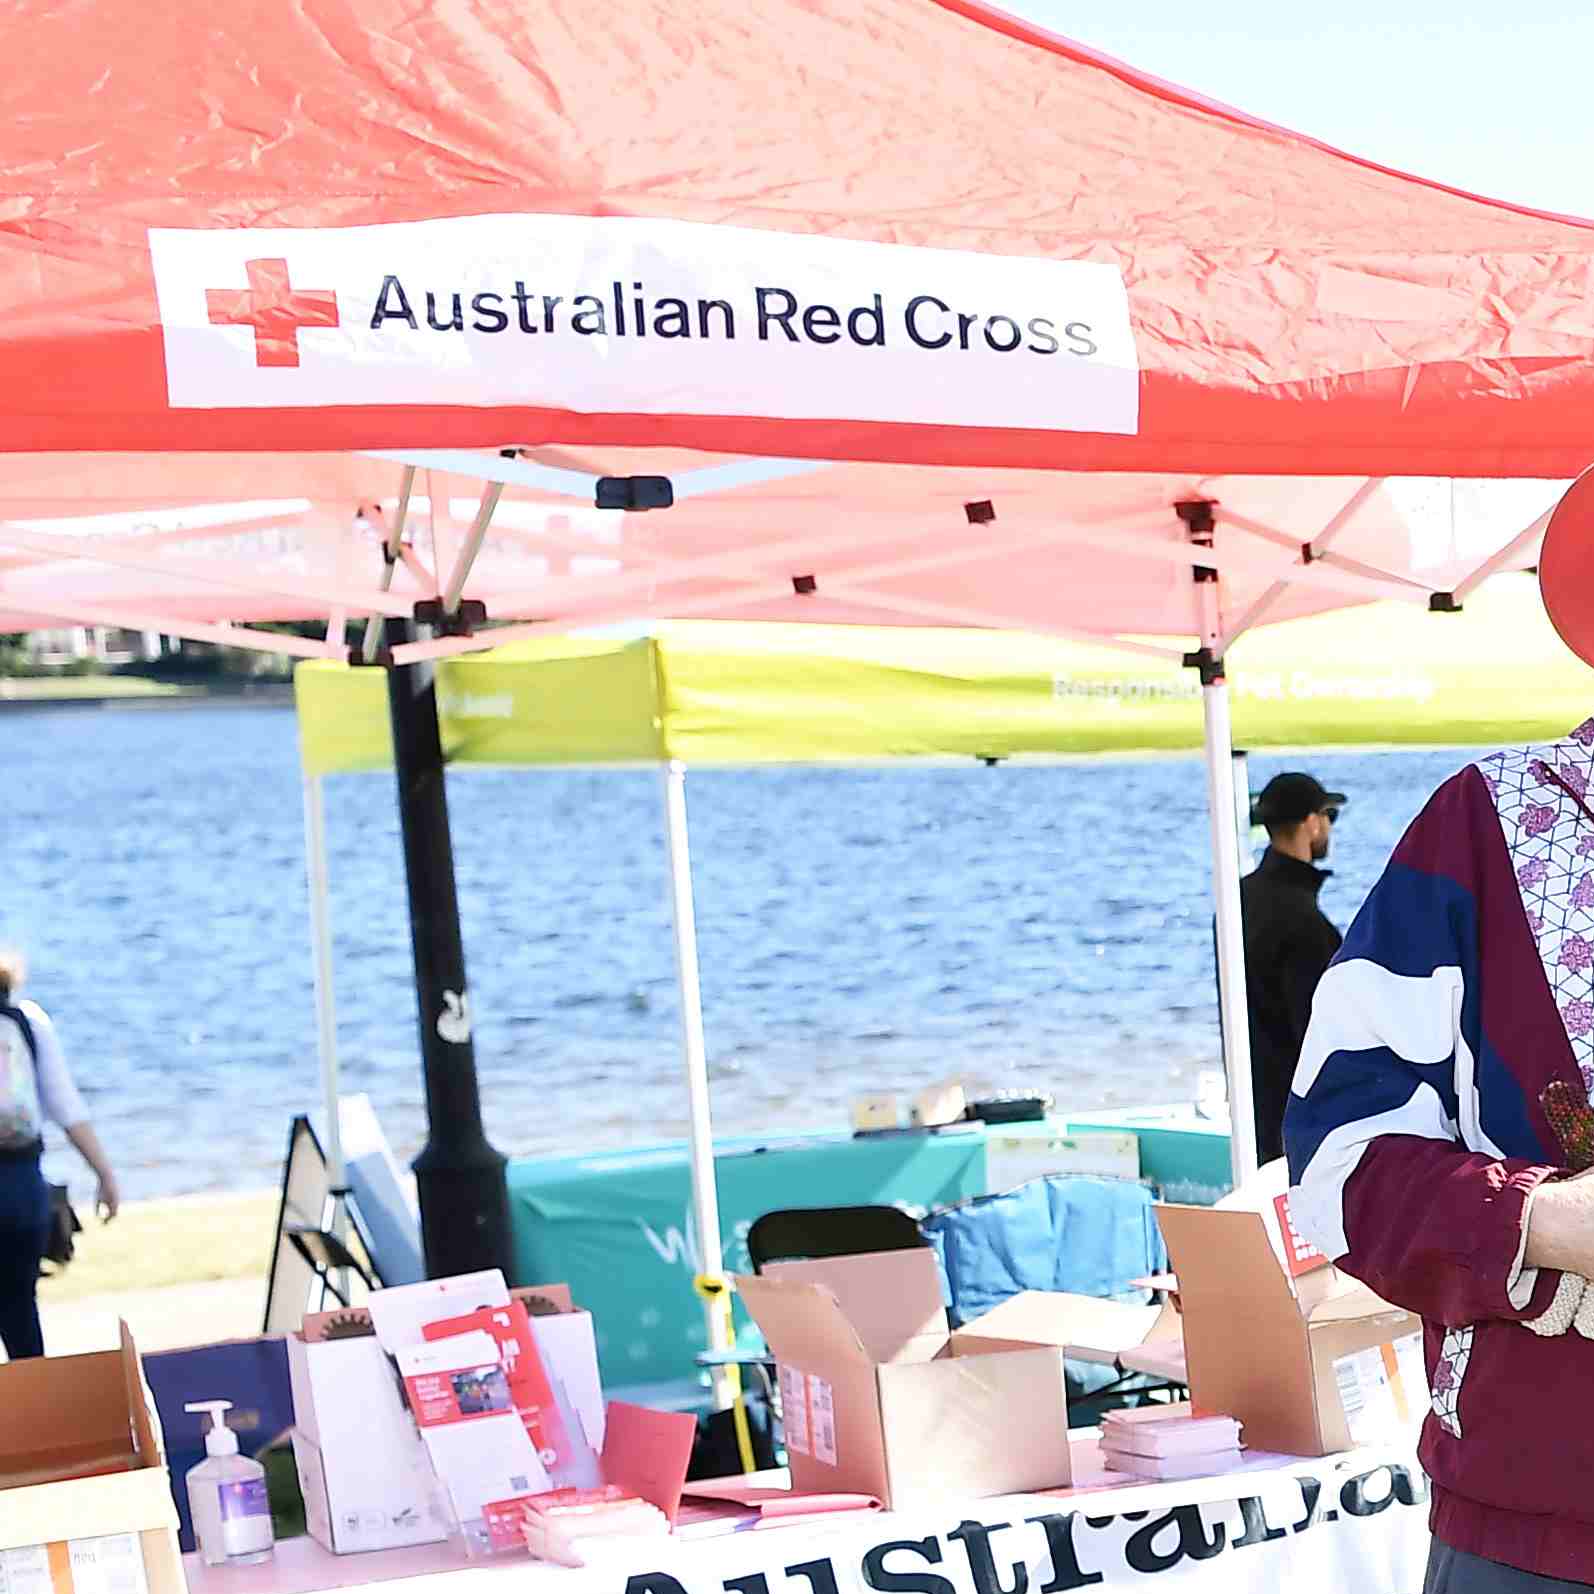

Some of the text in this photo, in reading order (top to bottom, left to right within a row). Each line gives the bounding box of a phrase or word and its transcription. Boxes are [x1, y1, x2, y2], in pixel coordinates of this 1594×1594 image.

[370, 275, 1099, 357] Australian Red Cross
